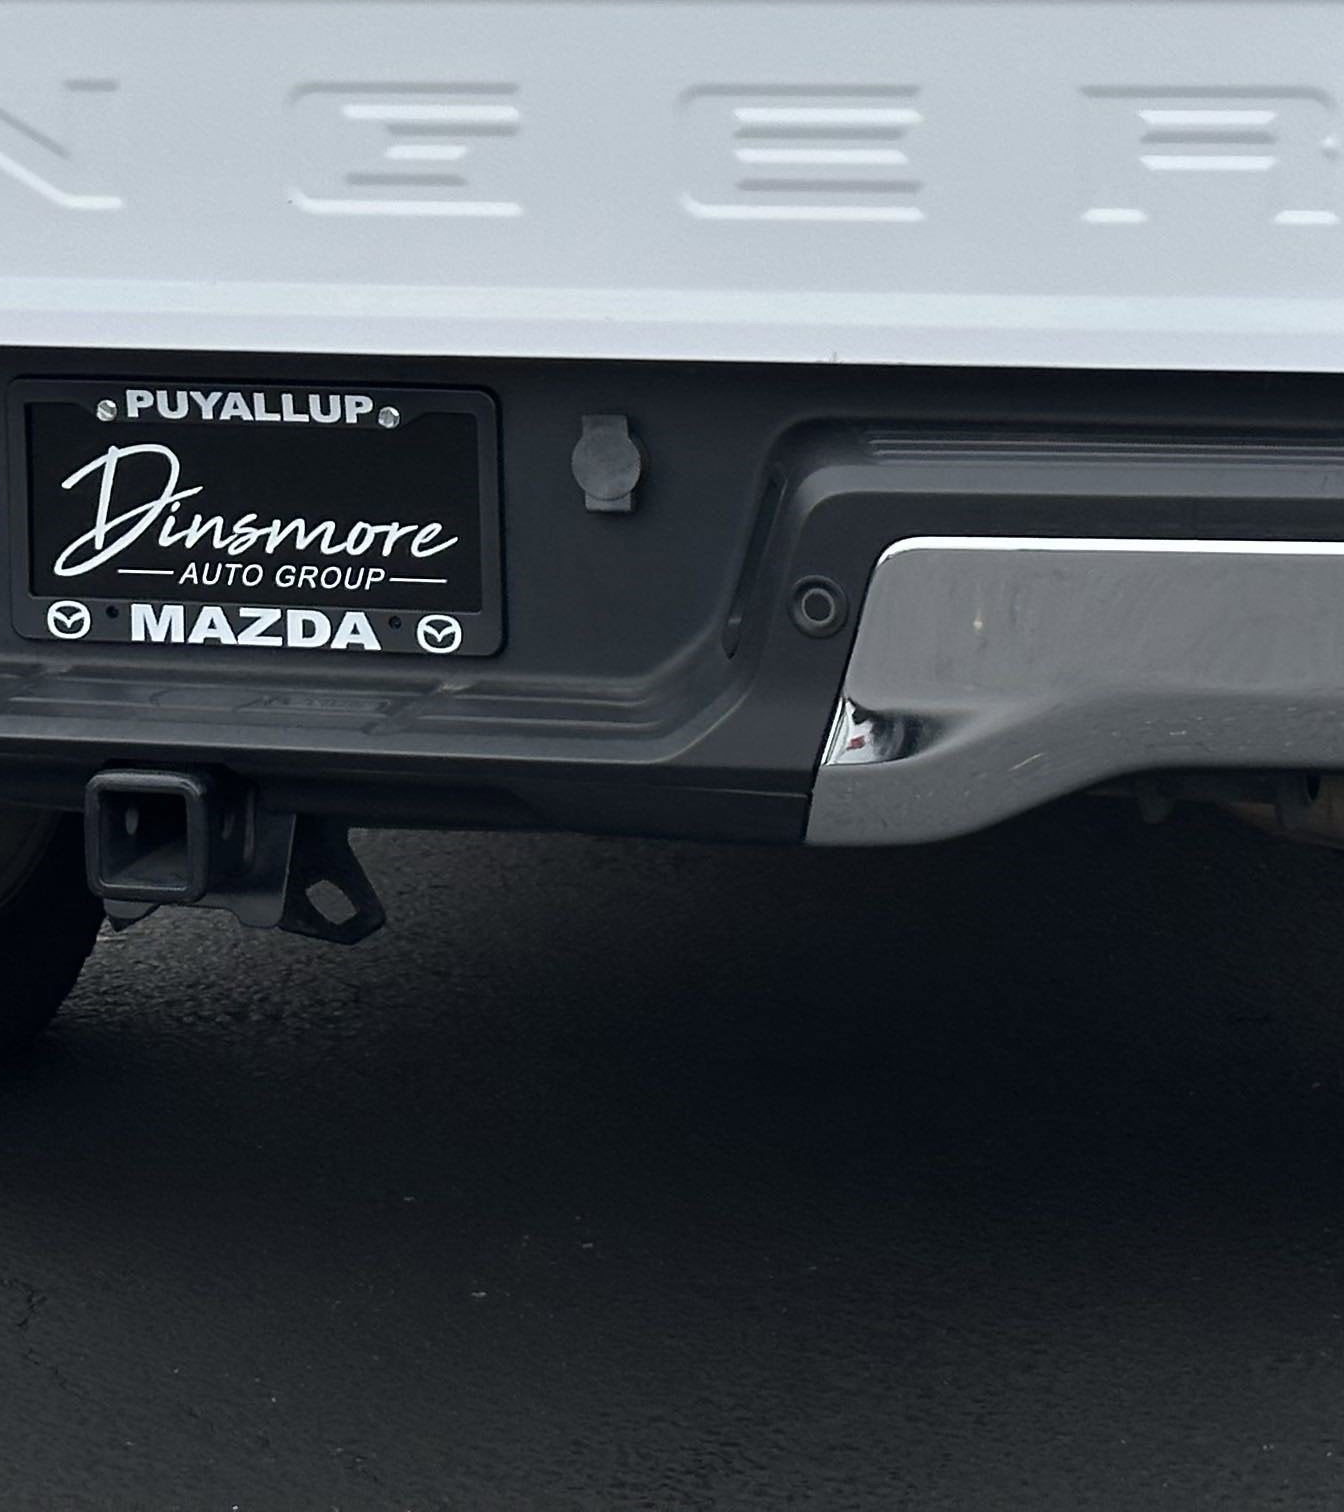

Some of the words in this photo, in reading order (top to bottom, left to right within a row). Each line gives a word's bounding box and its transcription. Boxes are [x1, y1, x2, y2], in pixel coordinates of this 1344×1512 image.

[125, 389, 374, 424] PUYALLUP
[53, 443, 459, 578] Dinsmore
[178, 562, 264, 587] AUTO
[274, 565, 386, 590] GROUP
[129, 603, 382, 651] MAZDA
